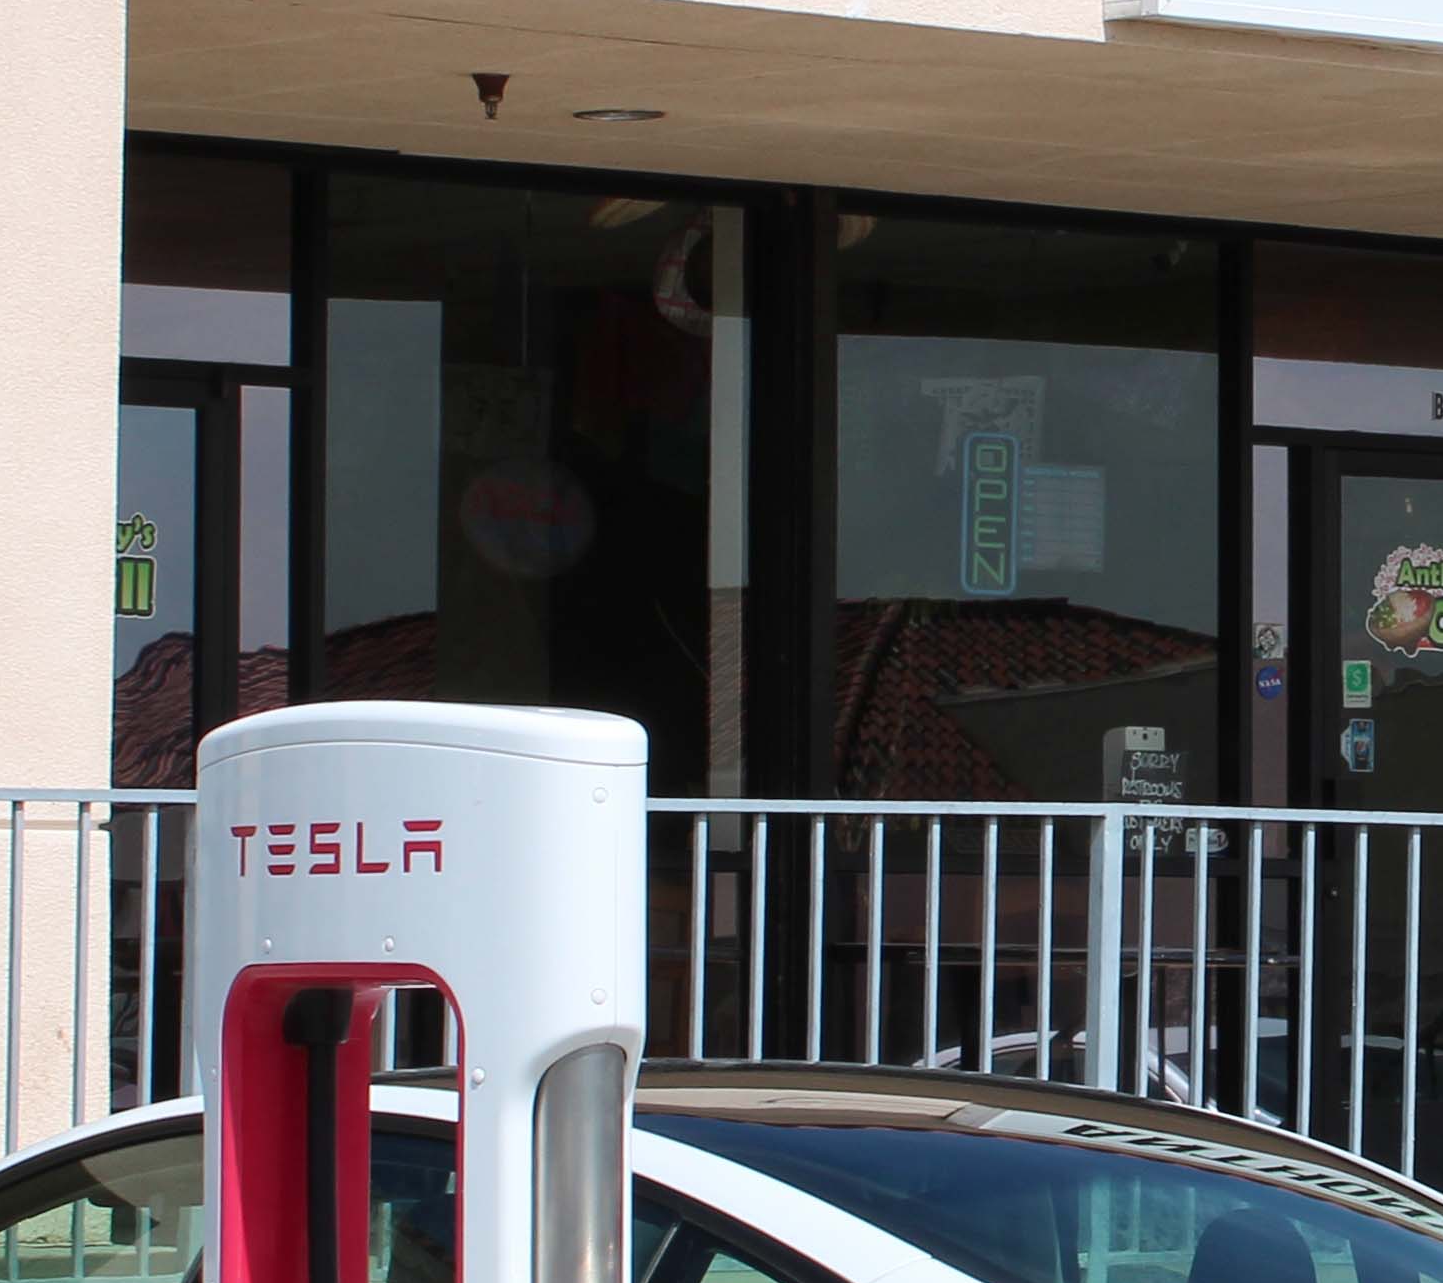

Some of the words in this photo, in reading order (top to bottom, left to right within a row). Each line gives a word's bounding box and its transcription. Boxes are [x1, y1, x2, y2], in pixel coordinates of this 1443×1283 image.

[972, 443, 1007, 586] OPEN
[1258, 678, 1282, 687] NASA
[1131, 751, 1180, 773] SORRY
[230, 820, 444, 877] TESLA
